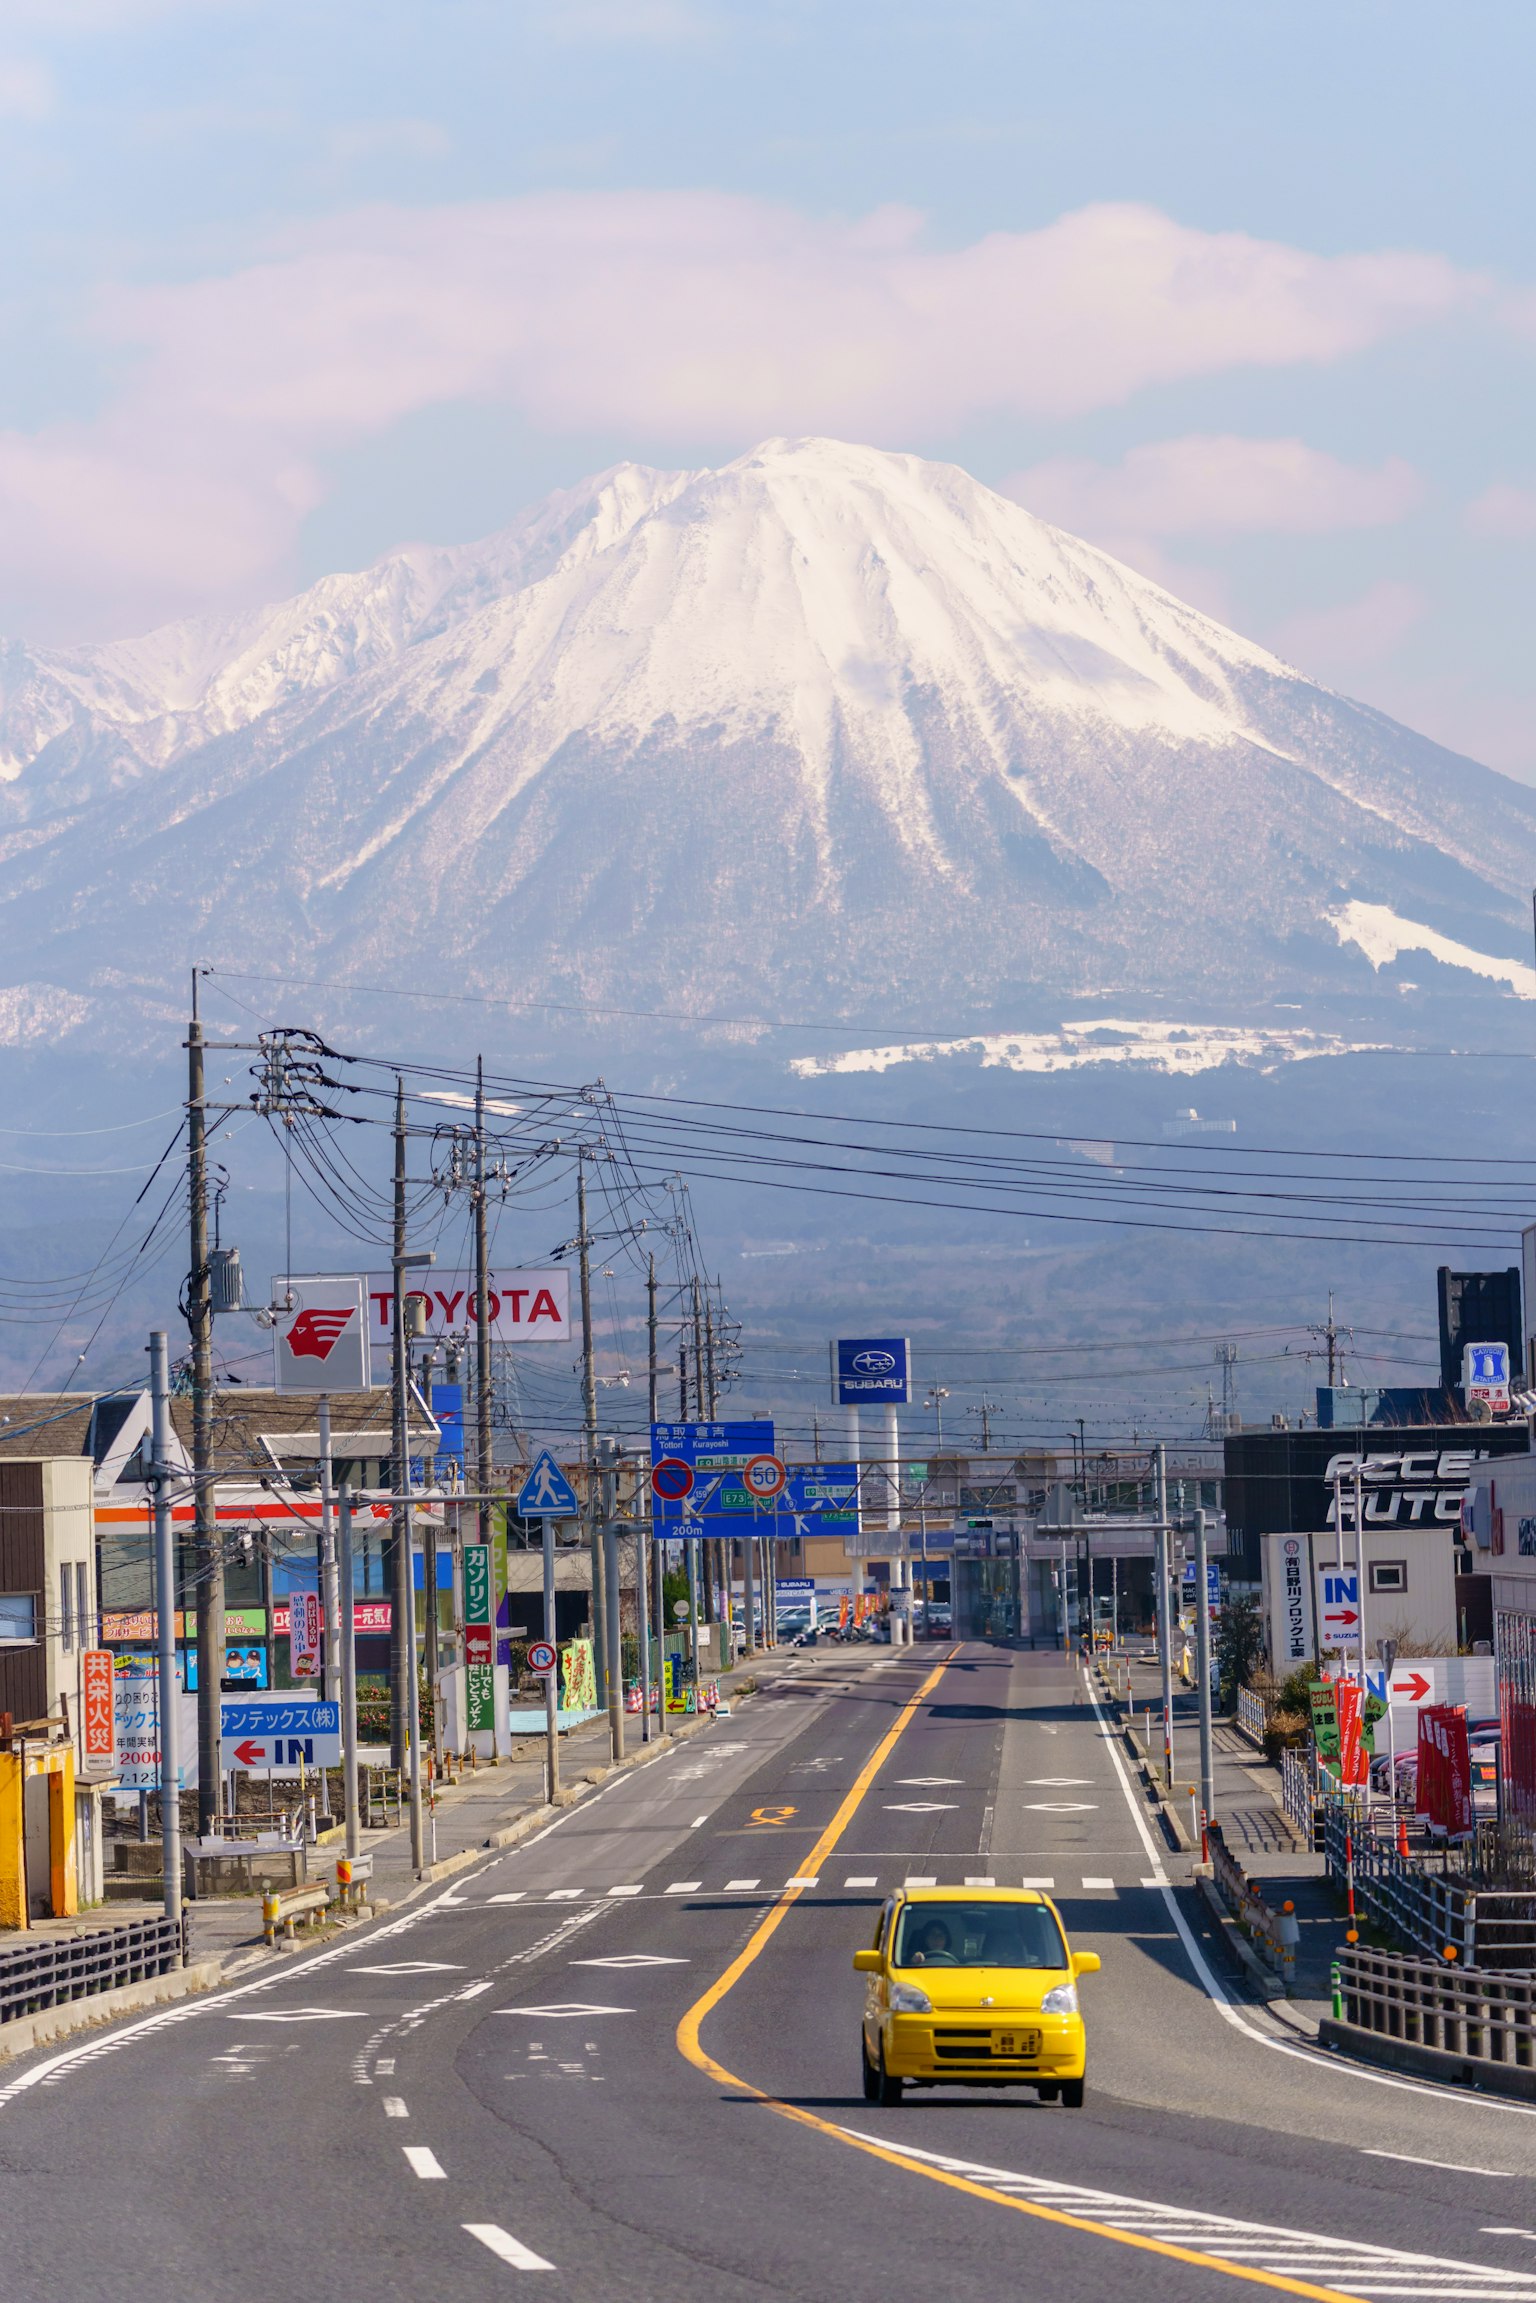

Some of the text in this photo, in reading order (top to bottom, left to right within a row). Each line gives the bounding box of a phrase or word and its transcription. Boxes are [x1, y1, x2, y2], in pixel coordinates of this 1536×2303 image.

[1473, 1347, 1503, 1356] LAWSON
[844, 1379, 903, 1390] SUBARU
[1474, 1374, 1504, 1383] STATION
[656, 1425, 726, 1440] 鳥取 倉吉
[659, 1439, 729, 1449] Tottori Kurayoshi
[1119, 1456, 1218, 1470] SUARU
[752, 1466, 776, 1485] 50
[695, 1490, 707, 1499] 159
[725, 1494, 744, 1503] E73
[672, 1526, 703, 1536] 200m
[467, 1550, 487, 1620] ガソリン
[1324, 1576, 1358, 1604] IN
[87, 1654, 110, 1751] 共栄火災
[274, 1738, 314, 1765] IN
